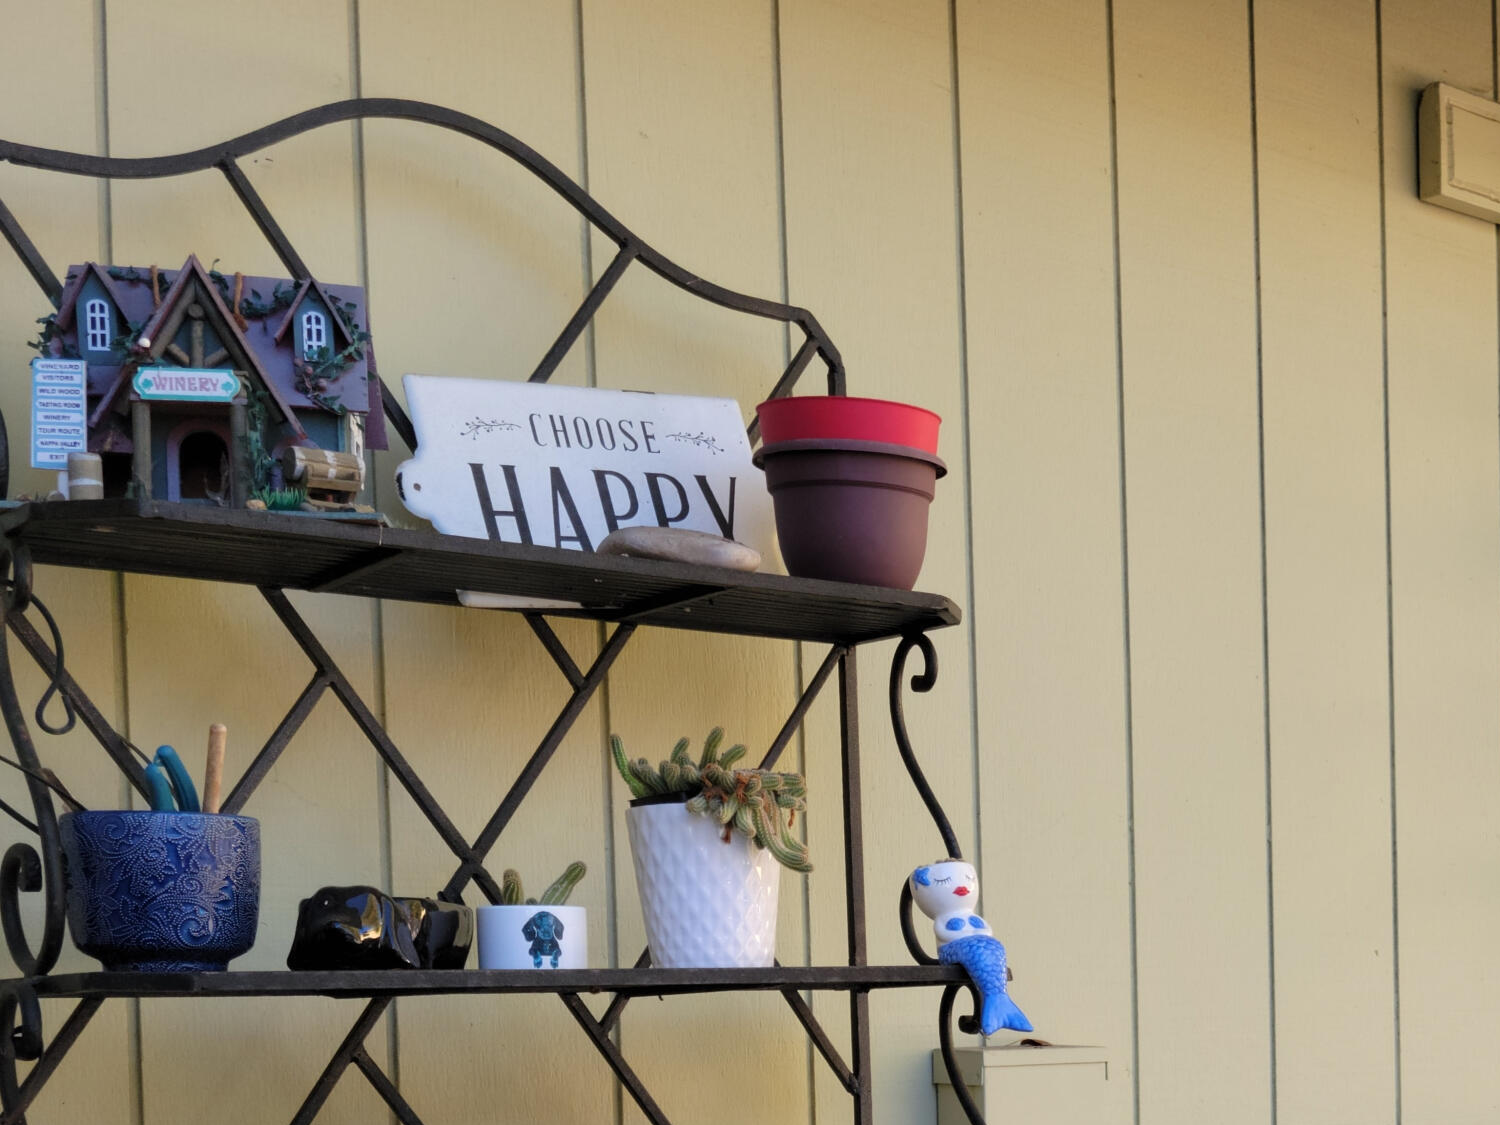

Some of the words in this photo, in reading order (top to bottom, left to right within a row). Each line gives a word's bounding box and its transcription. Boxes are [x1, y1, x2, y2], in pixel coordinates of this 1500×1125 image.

[152, 376, 220, 392] WINERY
[528, 413, 661, 454] CHOOSE
[467, 462, 736, 552] HAPPY
